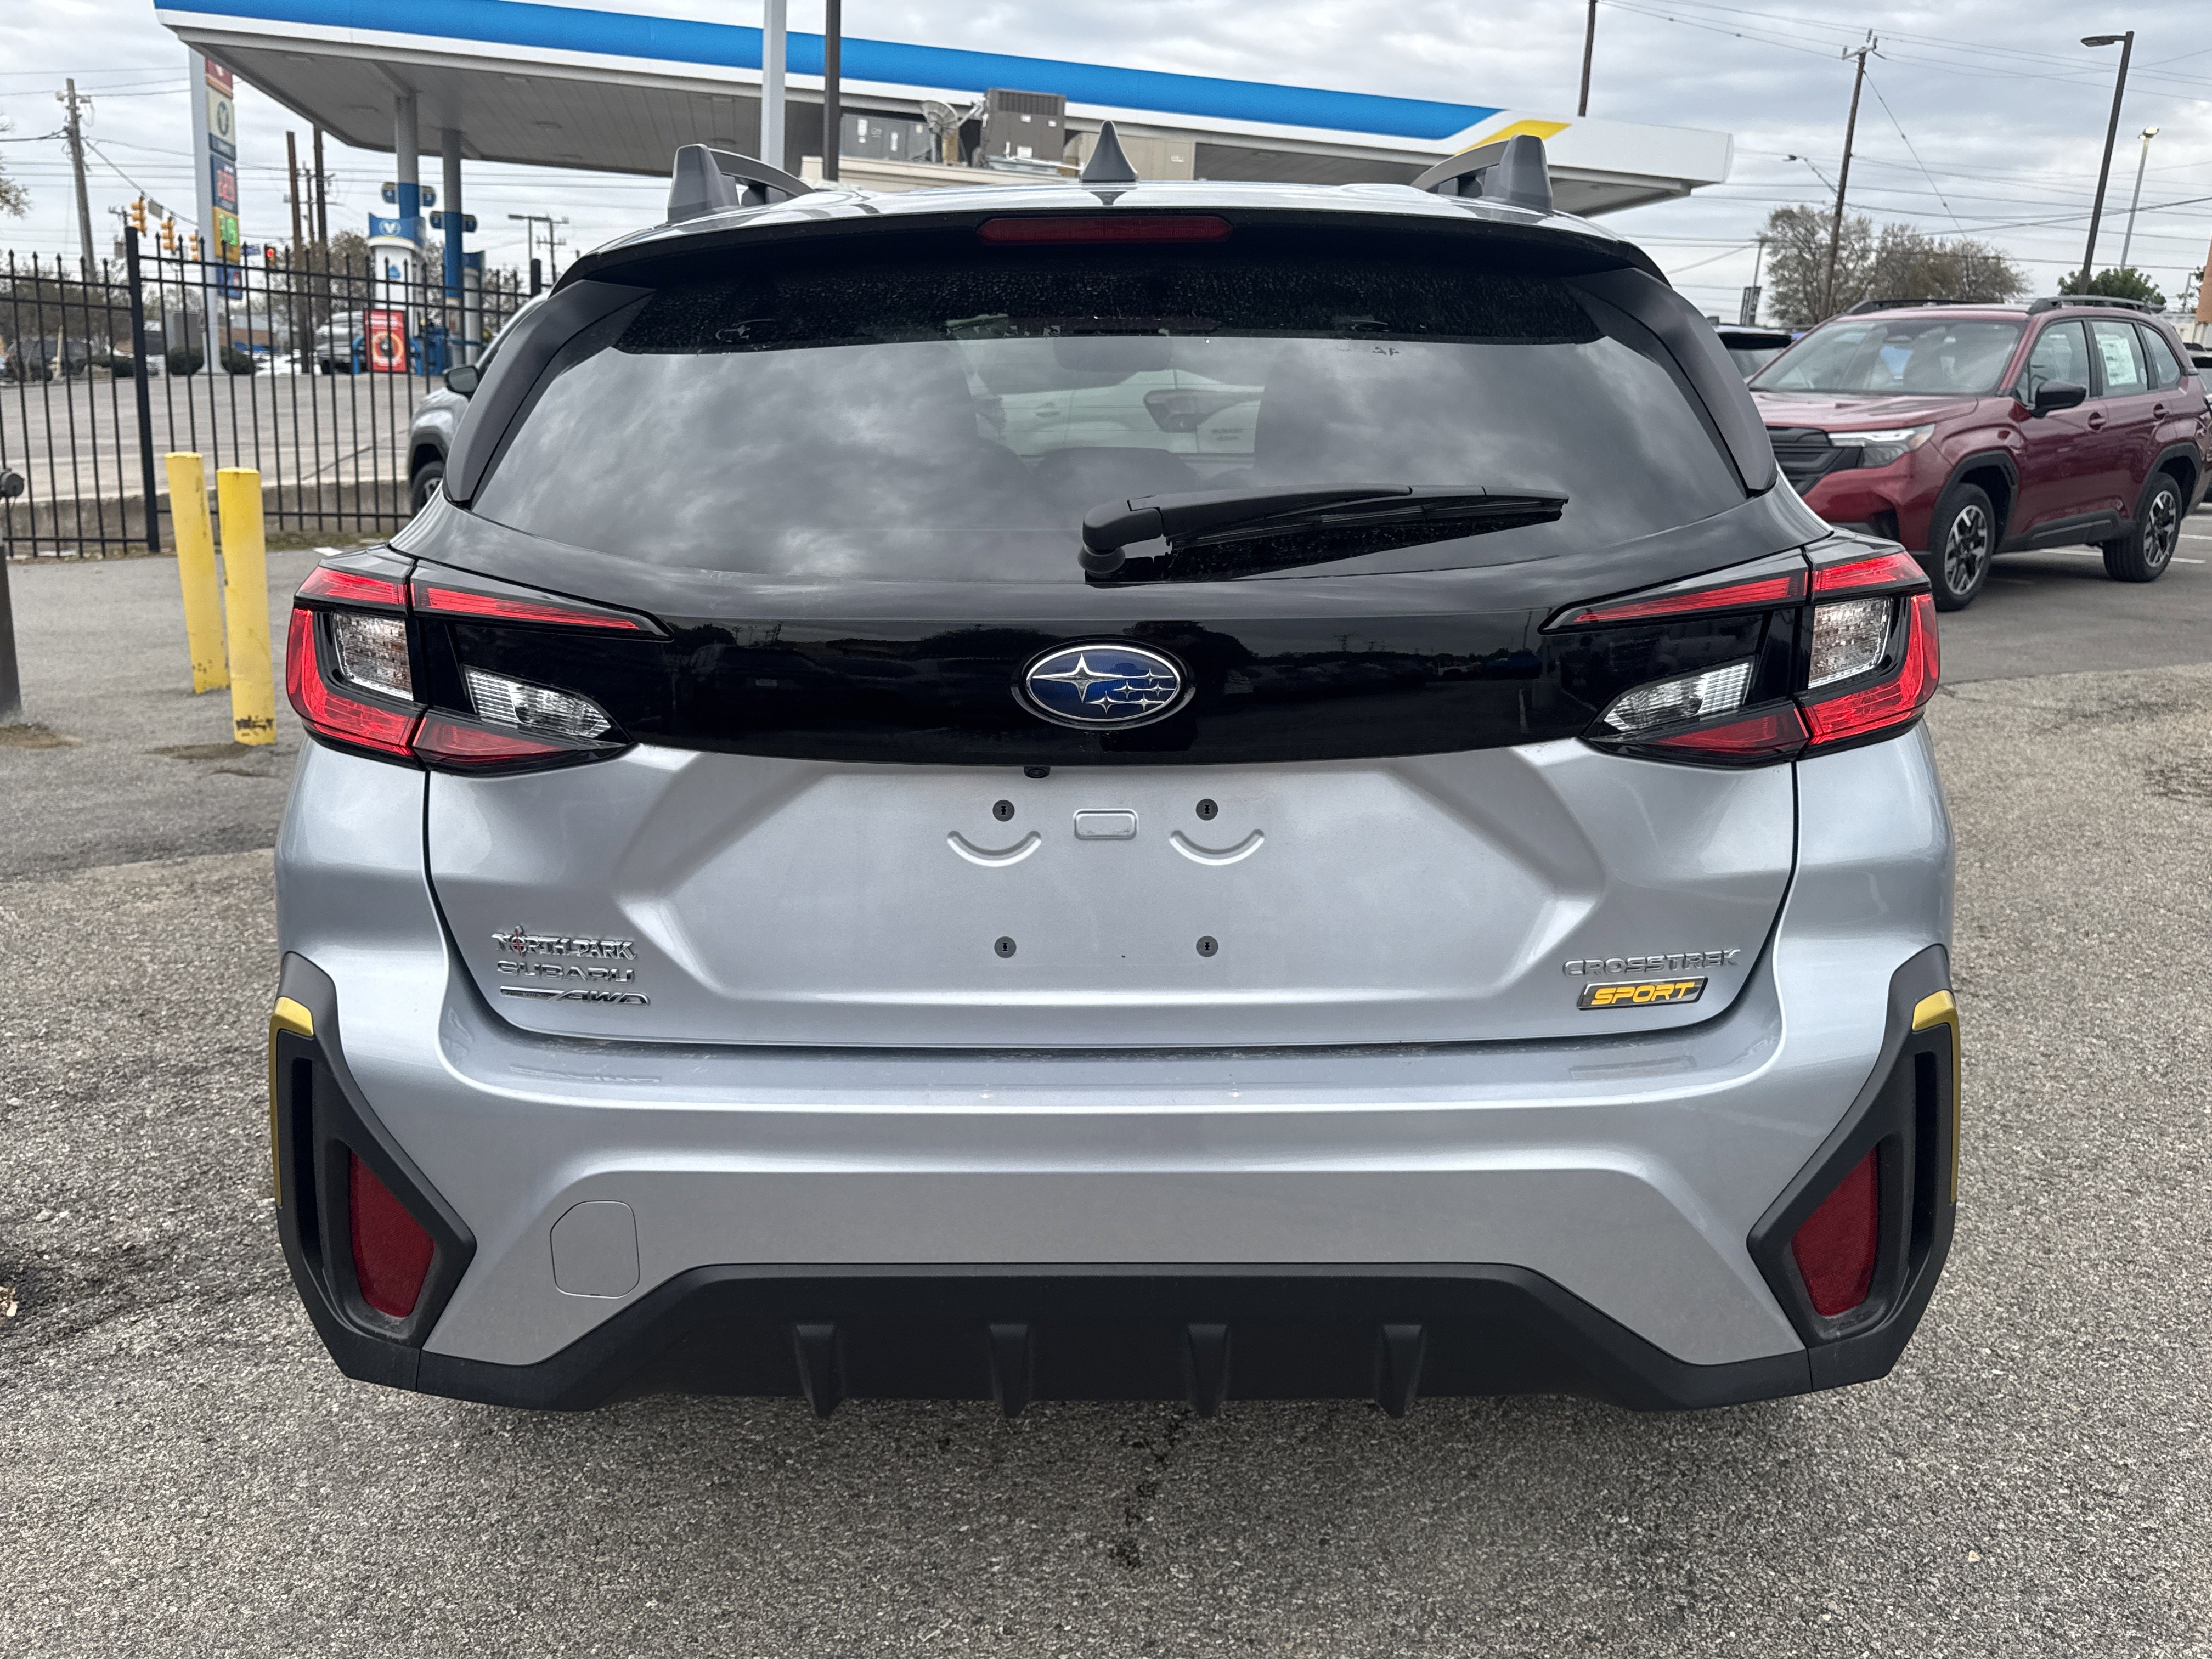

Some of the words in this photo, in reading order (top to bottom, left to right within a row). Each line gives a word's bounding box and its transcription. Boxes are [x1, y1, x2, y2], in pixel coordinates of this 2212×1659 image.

[497, 960, 635, 984] SUBARU
[1563, 948, 1741, 977] CROSSTREK
[550, 989, 651, 1006] AWD
[1591, 981, 1696, 1005] SPORT
